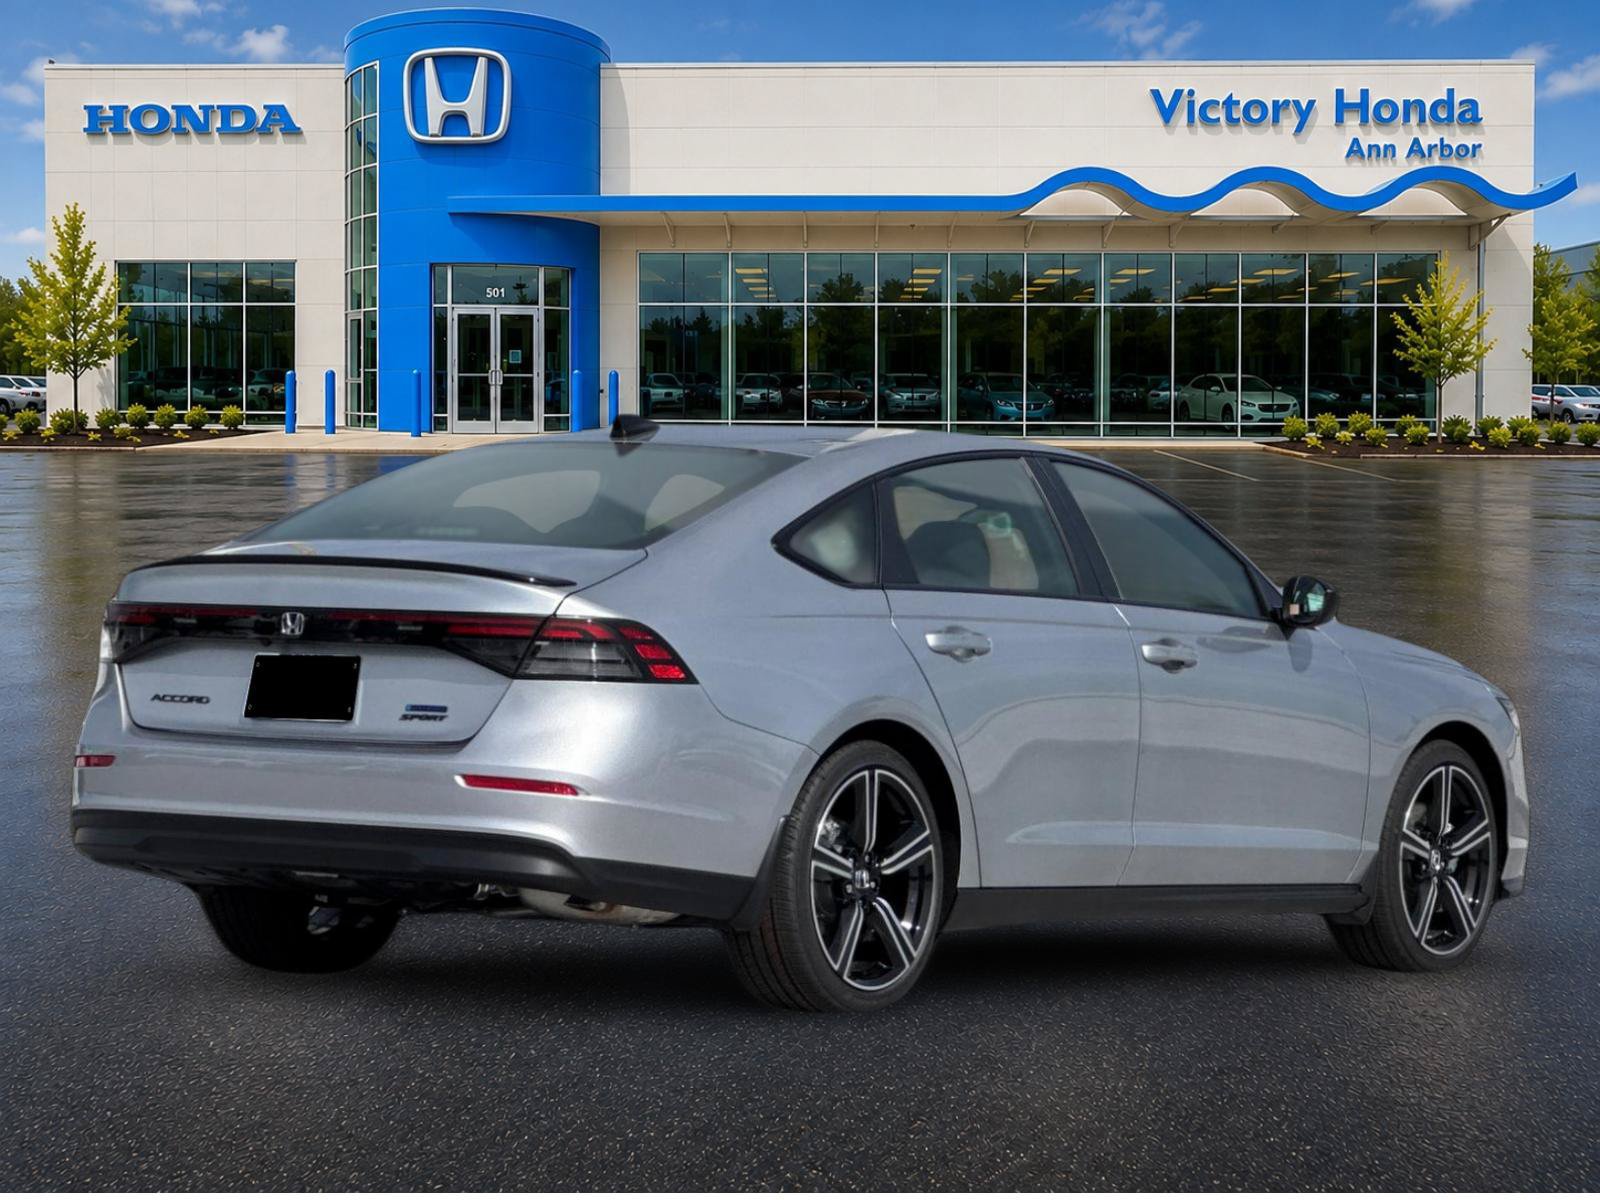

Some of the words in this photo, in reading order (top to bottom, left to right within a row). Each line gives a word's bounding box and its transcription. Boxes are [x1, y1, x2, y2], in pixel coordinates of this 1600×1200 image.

[83, 103, 302, 135] HONDA
[1150, 88, 1316, 135] Victory
[1335, 88, 1484, 126] Honda
[1345, 137, 1397, 160] Ann
[1406, 137, 1482, 160] Arbor
[486, 287, 505, 298] 501
[151, 694, 210, 704] ACCORD
